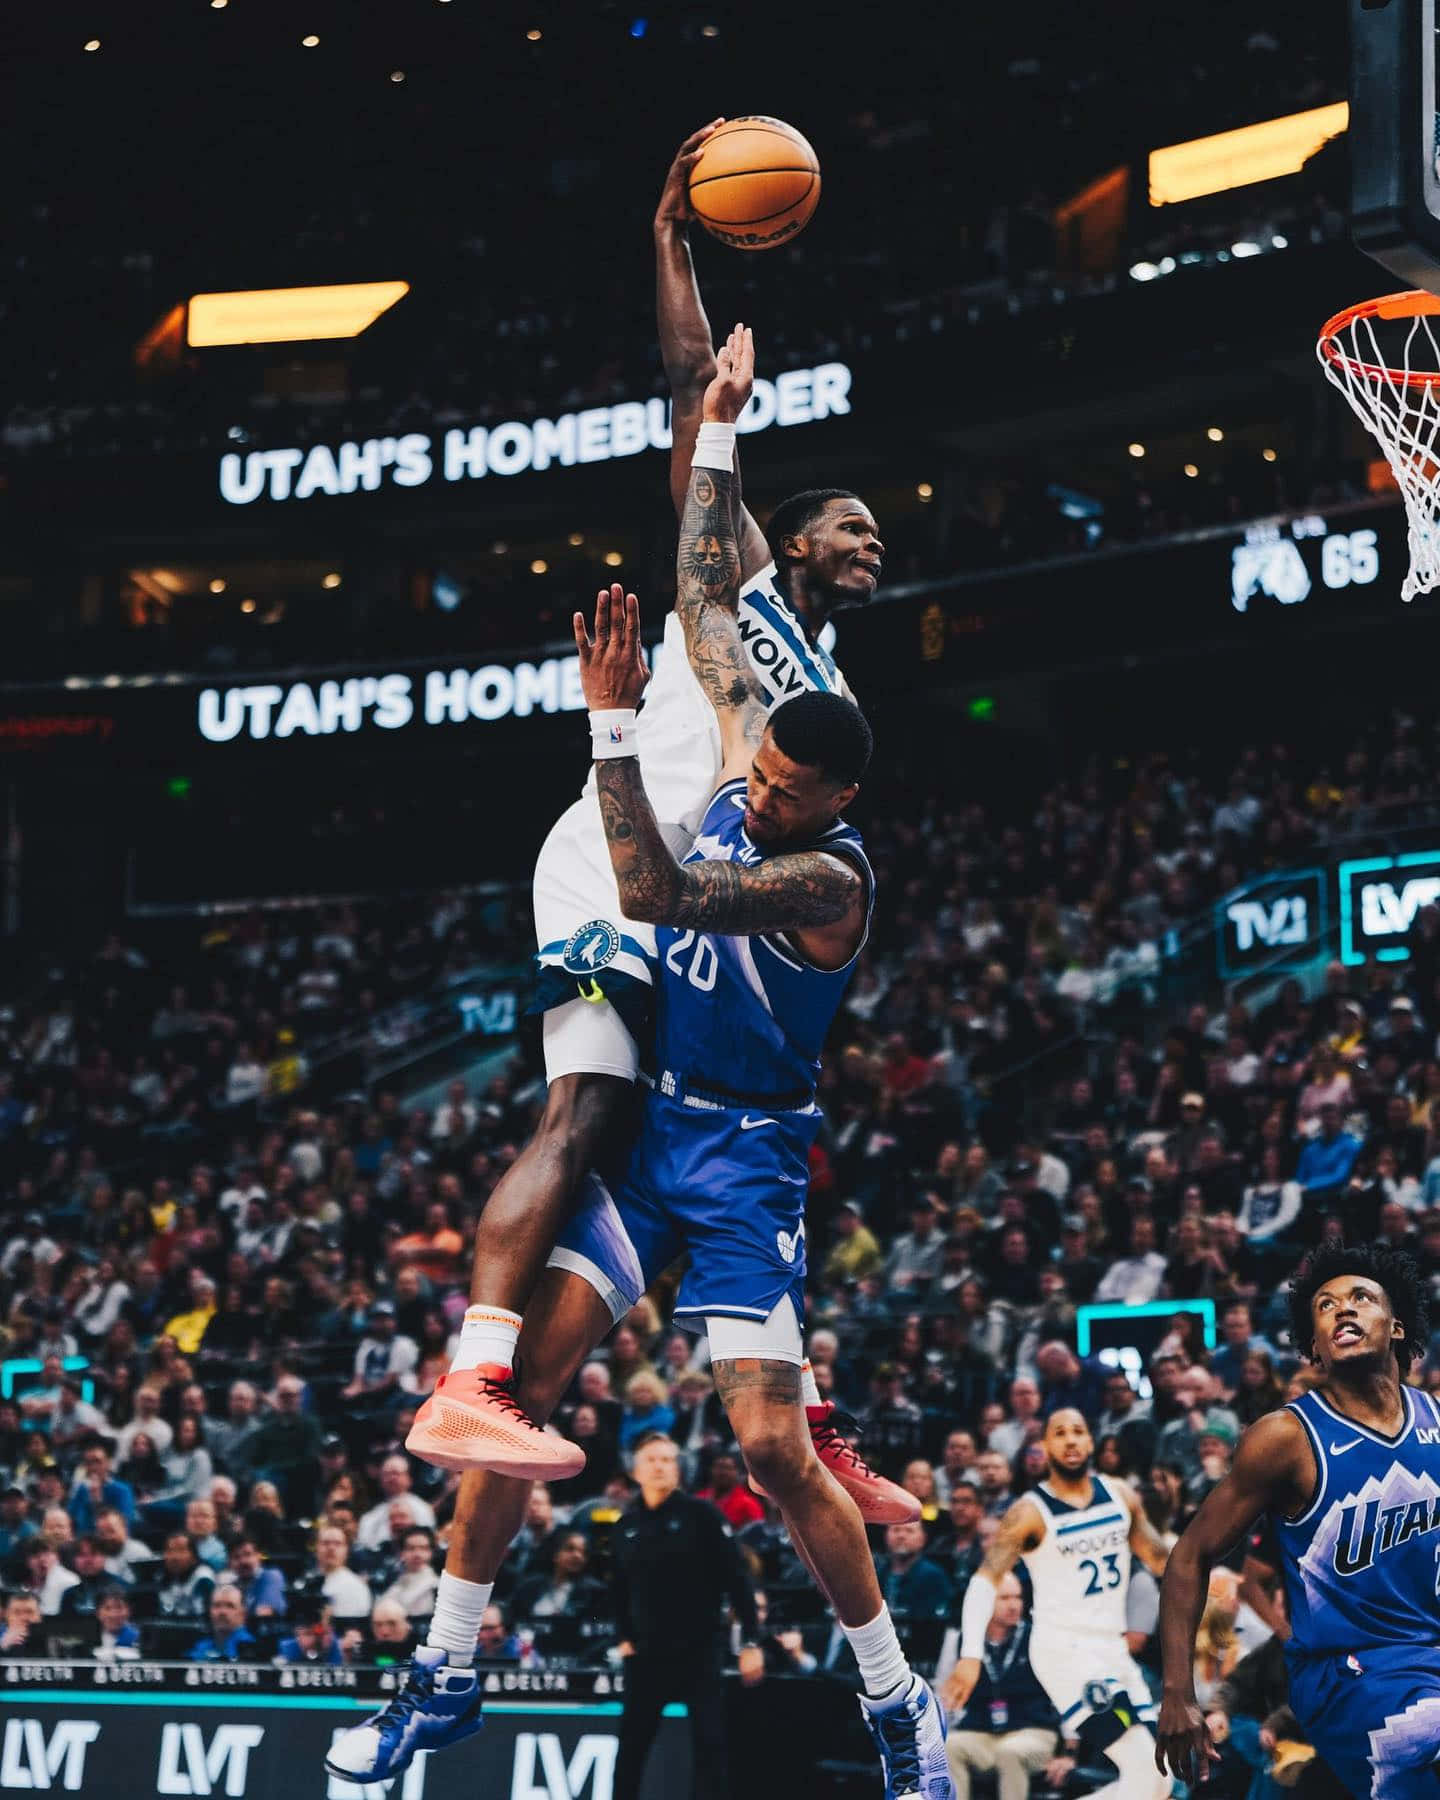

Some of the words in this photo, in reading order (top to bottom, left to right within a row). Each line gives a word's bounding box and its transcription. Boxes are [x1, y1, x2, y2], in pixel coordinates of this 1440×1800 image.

[220, 433, 433, 505] UTAH'S
[444, 362, 853, 481] HOMEBUDER
[1322, 529, 1379, 589] 65
[737, 611, 804, 695] WOLV
[198, 673, 414, 742] UTAH'S
[666, 926, 719, 992] 20
[1333, 1496, 1440, 1577] UTA
[1079, 1553, 1121, 1597] 23
[21, 1667, 73, 1681] DELTA
[109, 1667, 164, 1682] DELTA
[202, 1669, 259, 1684] DELTA
[298, 1671, 356, 1687] DELTA
[504, 1674, 568, 1691] DELTA
[1, 1718, 101, 1790] LVT
[157, 1722, 265, 1796] LVT
